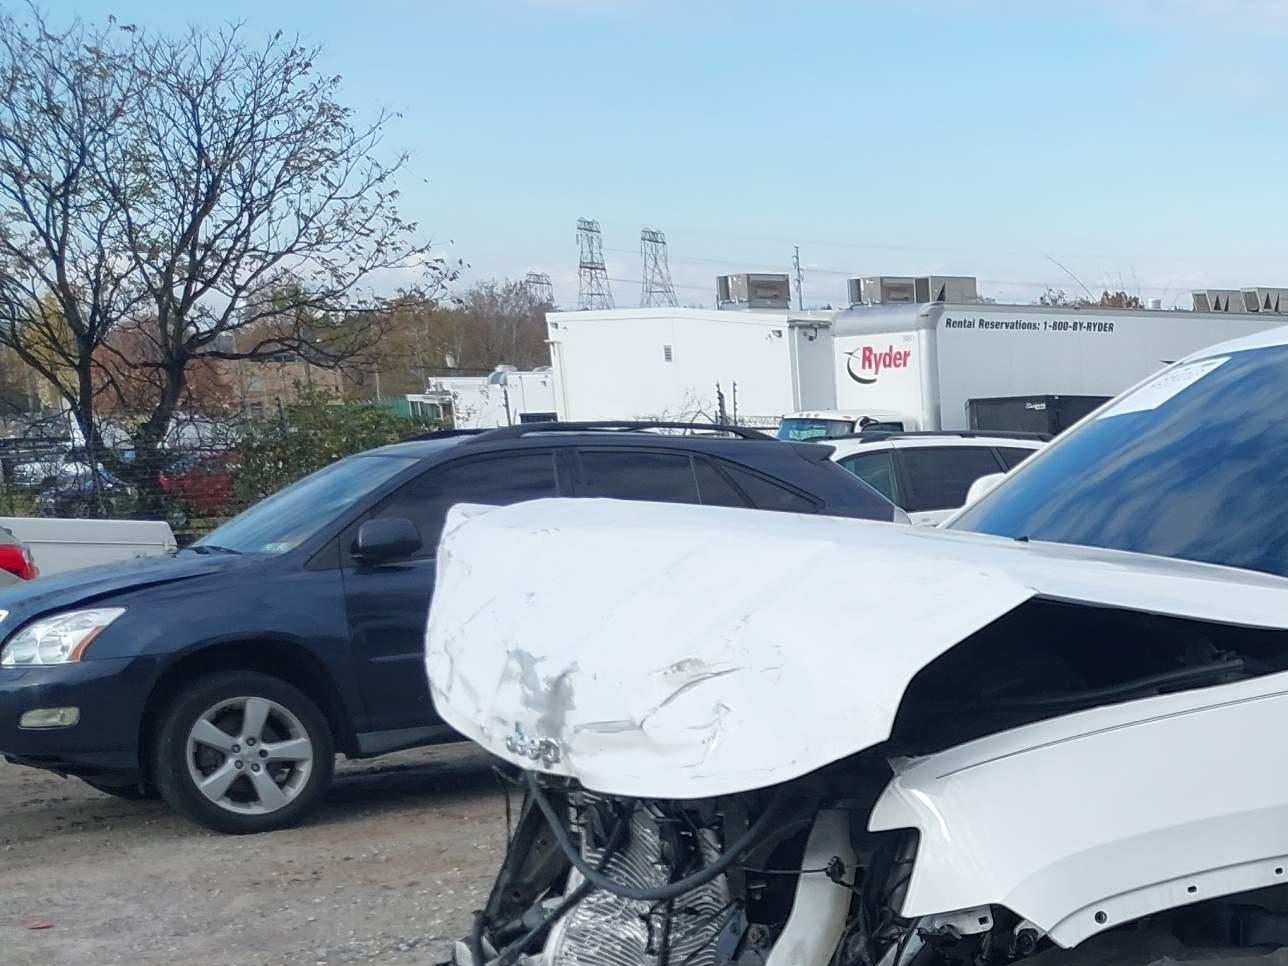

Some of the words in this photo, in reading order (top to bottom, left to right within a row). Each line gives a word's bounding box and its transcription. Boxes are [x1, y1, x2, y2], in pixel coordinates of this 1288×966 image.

[945, 318, 975, 329] Rental
[978, 319, 1040, 331] Reservations:
[1043, 321, 1115, 333] 1-800-BY-RYDER
[862, 344, 911, 375] Ryder
